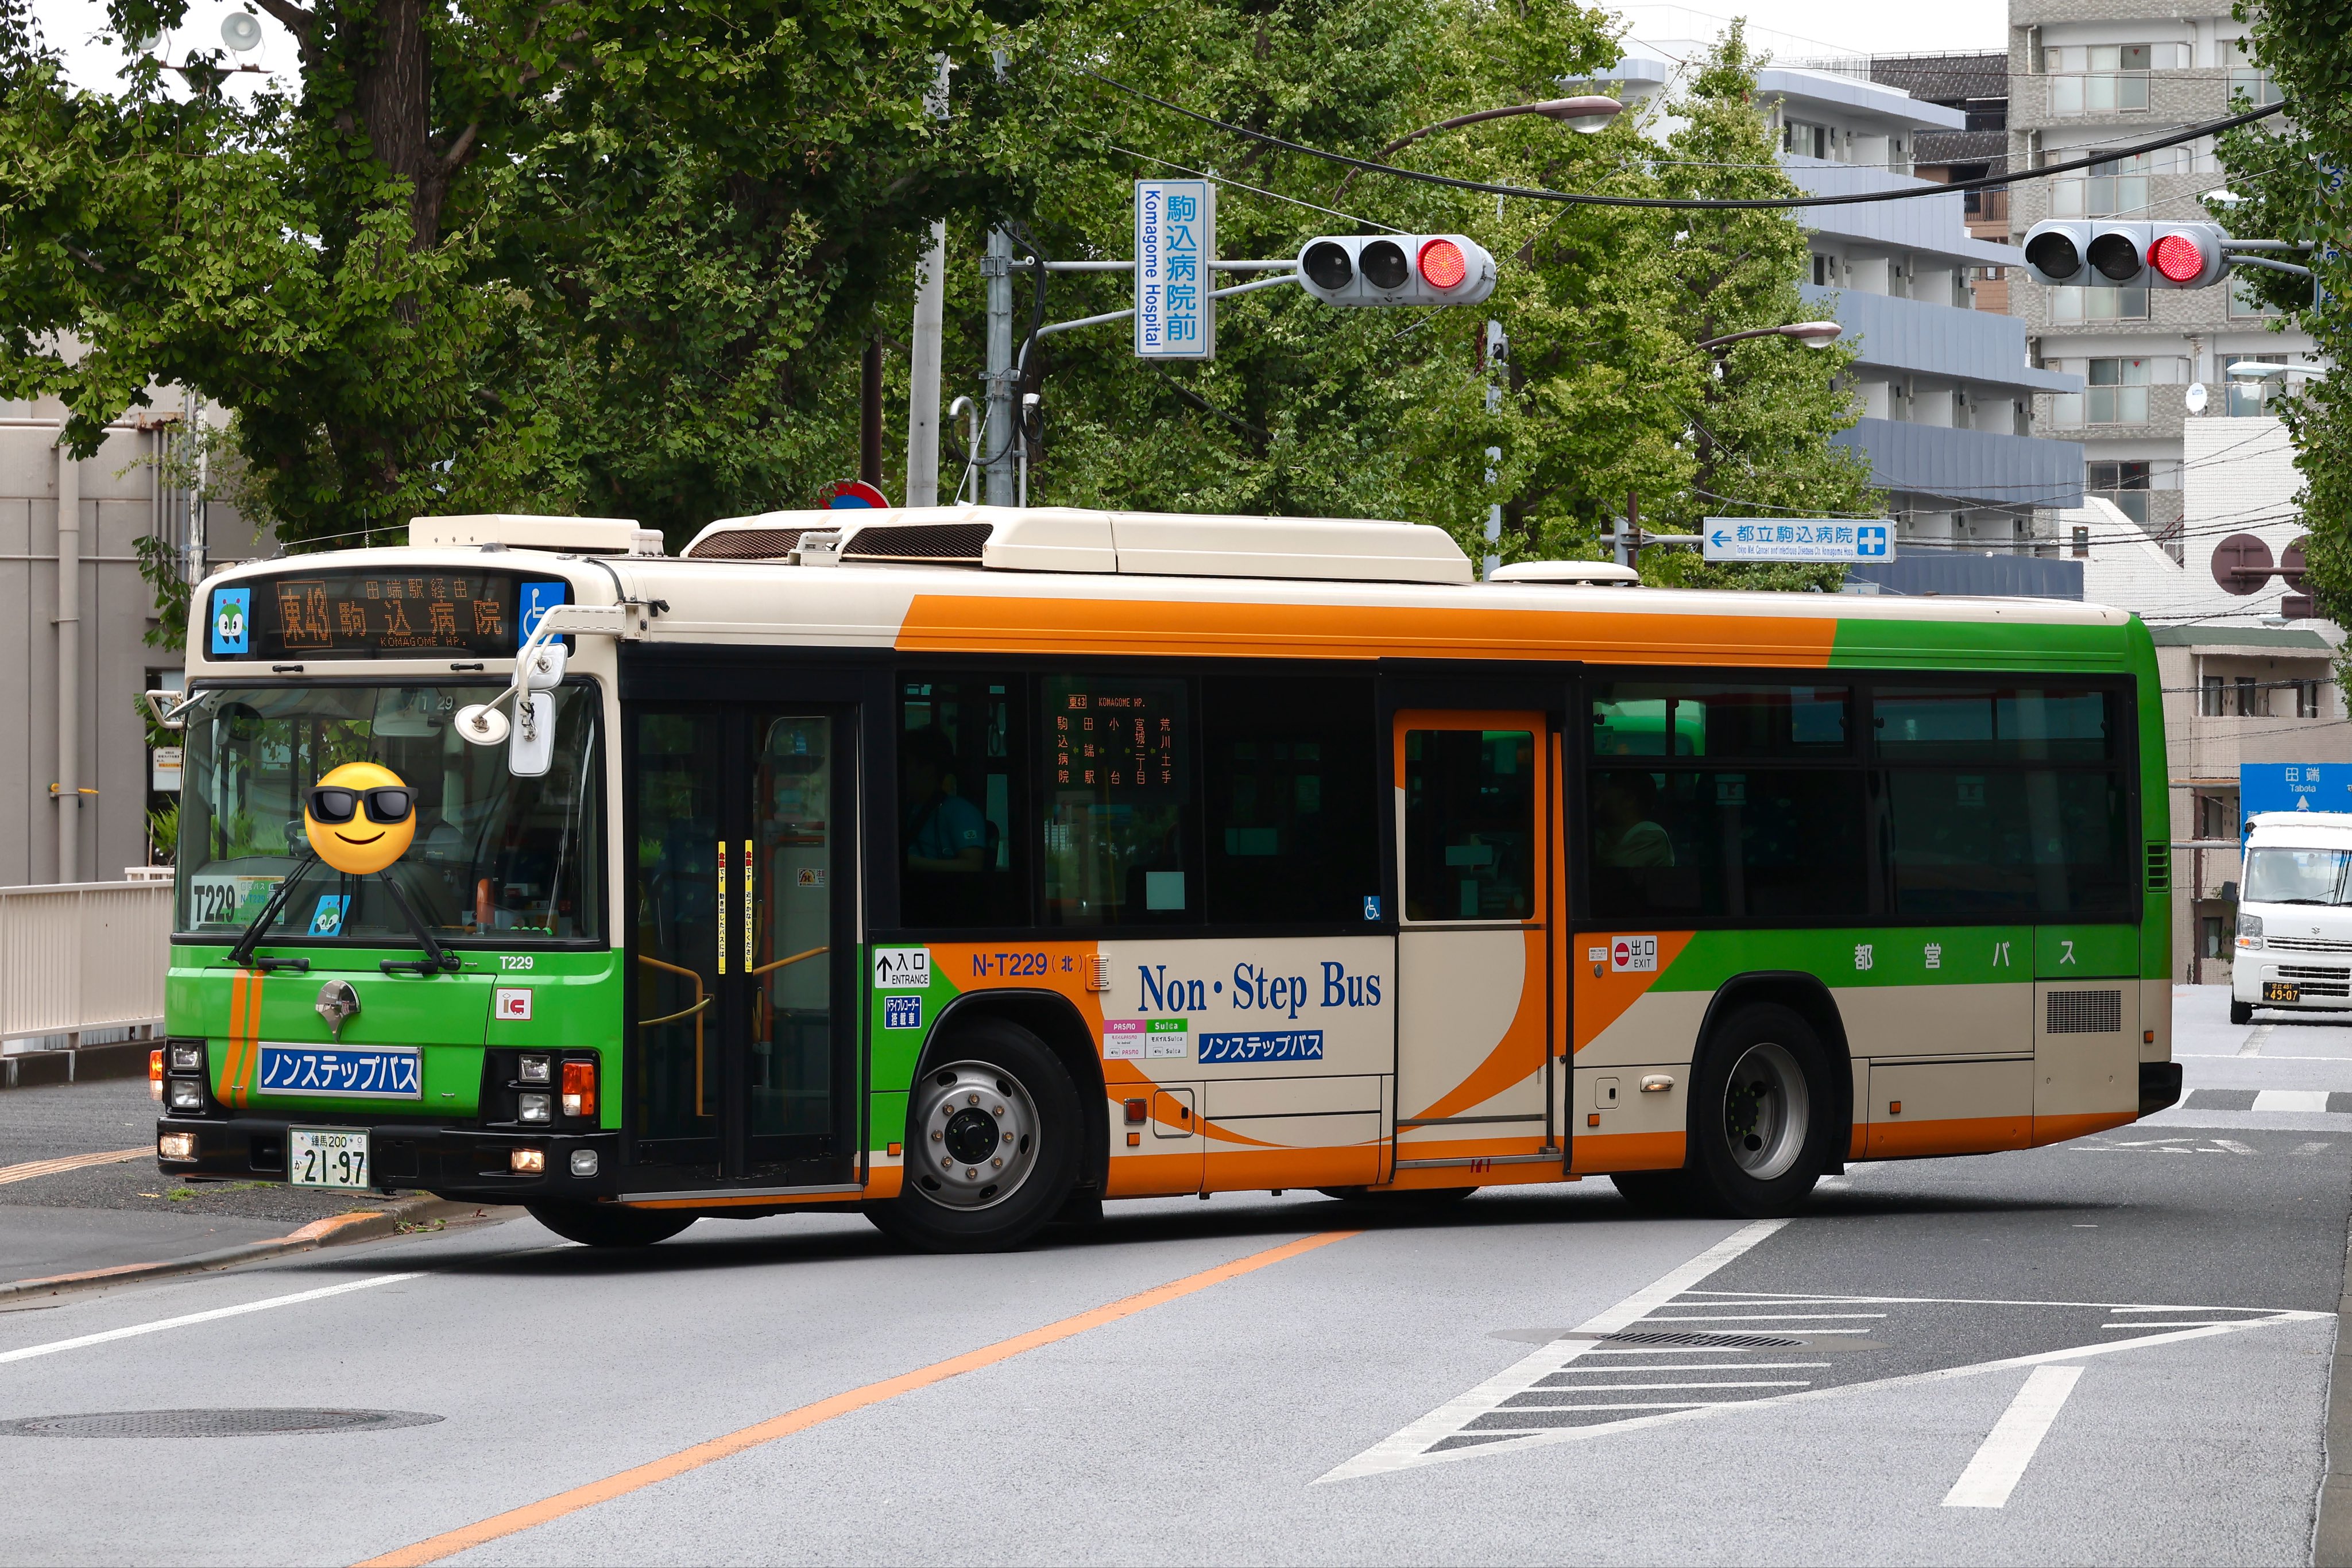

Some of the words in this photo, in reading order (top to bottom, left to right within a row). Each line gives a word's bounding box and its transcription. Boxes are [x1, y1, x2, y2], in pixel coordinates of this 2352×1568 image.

[1143, 191, 1160, 278] Komagome
[1166, 195, 1197, 341] 駒込病院前
[1142, 284, 1160, 346] Hospital
[1736, 525, 1852, 543] 都立駒込病院
[1756, 545, 1769, 555] Cancer
[1778, 546, 1797, 555] Infectious
[1822, 547, 1843, 557] Komagome
[366, 578, 467, 599] 田端駅経由
[281, 589, 328, 641] 東43
[339, 599, 502, 637] 駒込病院
[381, 637, 438, 646] KOMAGOME
[1069, 697, 1085, 707] 東43
[1098, 698, 1130, 707] KOMAGOME
[1134, 698, 1145, 707] HP.
[1057, 717, 1069, 783] 駒込病院
[1084, 718, 1094, 784] 田端駅
[1109, 718, 1120, 784] 小台
[1135, 718, 1145, 784] 宮城二丁目
[1160, 718, 1171, 783] 荒川土手
[2285, 768, 2319, 782] 田端
[2290, 784, 2316, 792] Tabata
[194, 885, 235, 923] T229
[1631, 940, 1654, 955] 出口
[1854, 940, 2076, 971] 都営バス
[500, 956, 533, 969] T229
[896, 954, 924, 971] 入口
[1634, 959, 1651, 967] EXIT
[892, 974, 928, 984] ENTRANCE
[1320, 961, 1381, 1007] Bus
[887, 998, 919, 1012] ドライブレコーダー
[2270, 989, 2298, 1001] 49-07
[891, 1012, 915, 1026] 搭載車
[1200, 1035, 1321, 1060] ノンステップバス
[264, 1054, 417, 1089] ノンステップバス
[304, 1149, 364, 1184] 21-97
